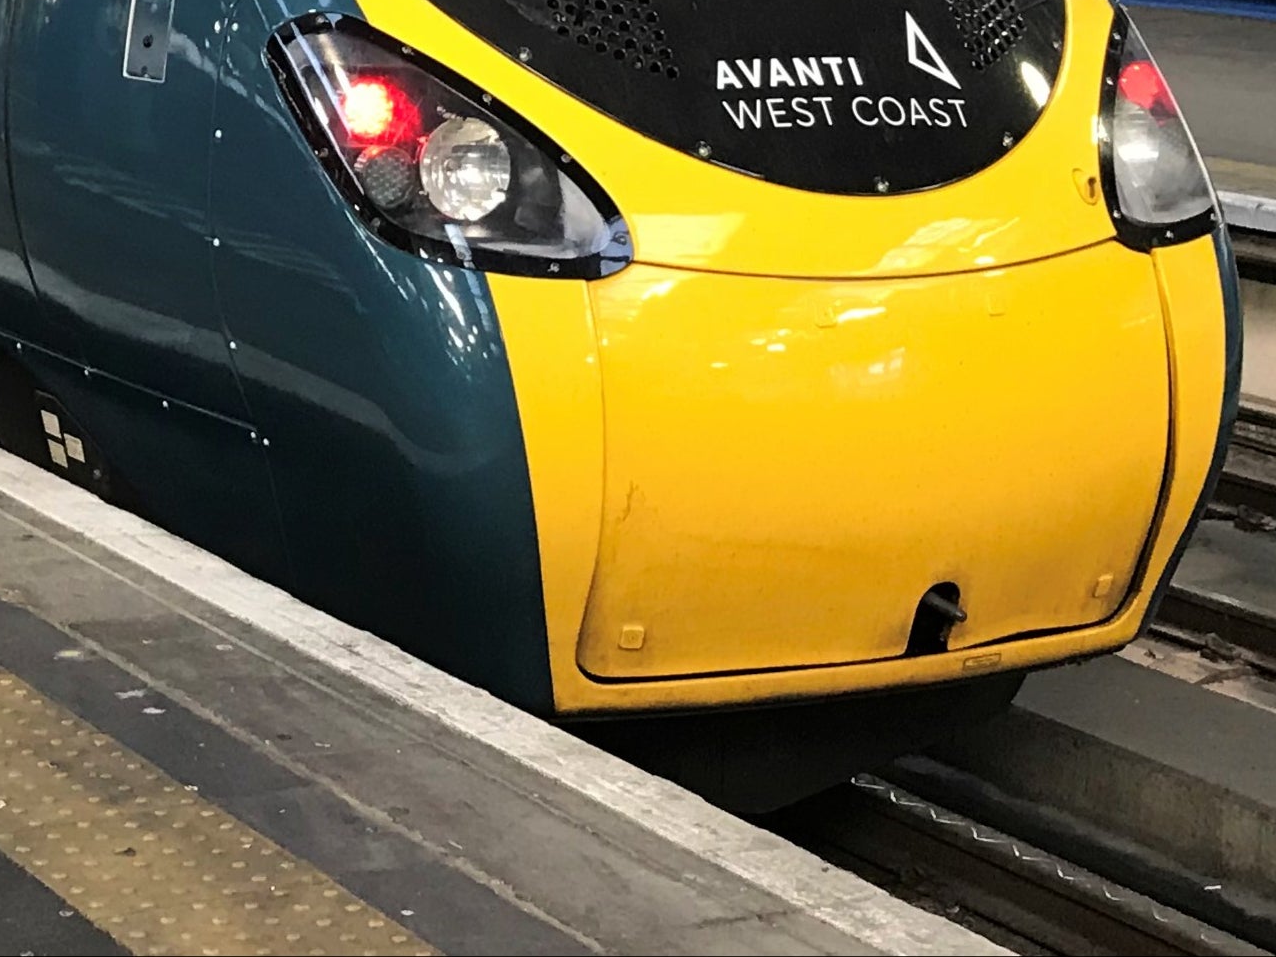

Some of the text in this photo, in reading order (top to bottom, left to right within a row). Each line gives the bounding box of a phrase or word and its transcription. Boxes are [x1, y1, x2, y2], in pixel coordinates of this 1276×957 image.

[716, 56, 864, 90] AVANTI
[722, 96, 968, 130] WEST COAST
